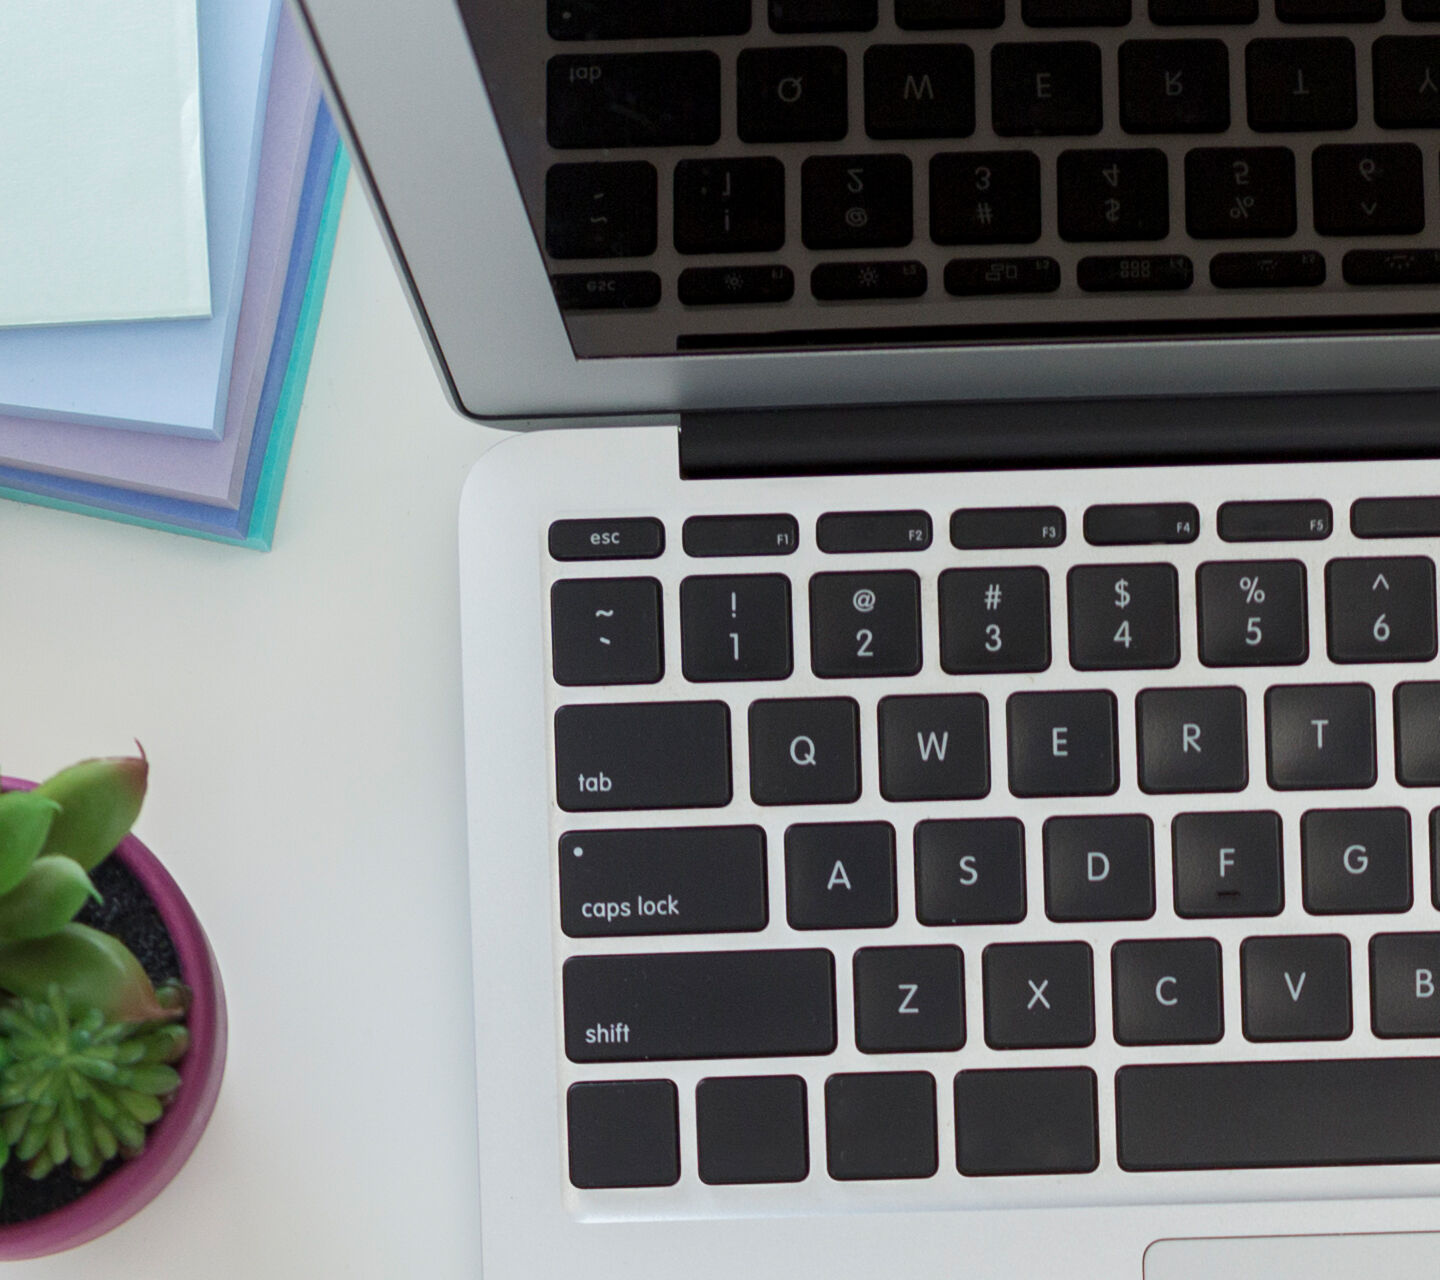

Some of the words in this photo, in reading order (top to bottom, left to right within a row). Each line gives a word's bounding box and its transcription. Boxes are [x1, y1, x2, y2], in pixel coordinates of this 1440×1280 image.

[590, 532, 620, 545] esc
[777, 533, 789, 545] F1
[908, 529, 923, 541] F2
[1042, 526, 1056, 538] F3
[1176, 521, 1191, 533] F4
[1310, 519, 1324, 531] F5
[1114, 578, 1131, 609] $
[1239, 576, 1266, 603] %
[1372, 573, 1390, 590] ^
[731, 591, 737, 618] !
[852, 589, 876, 612] @
[984, 583, 1002, 610] #
[985, 623, 1002, 652] 3
[1113, 620, 1132, 648] 4
[1245, 617, 1262, 645] 5
[1373, 613, 1390, 642] 6
[729, 632, 739, 661] 1
[856, 628, 874, 657] 2
[917, 731, 949, 761] W
[1052, 727, 1068, 756] E
[1182, 723, 1201, 753] R
[1311, 719, 1329, 749] T
[789, 735, 817, 766] Q
[578, 771, 612, 792] tab
[959, 855, 978, 886] S
[1087, 851, 1110, 881] D
[1219, 848, 1235, 877] F
[1343, 844, 1369, 874] G
[827, 860, 851, 890] A
[581, 901, 632, 922] caps
[637, 894, 680, 916] lock
[1027, 979, 1051, 1010] X
[1155, 976, 1178, 1006] C
[1284, 971, 1306, 1002] V
[1415, 968, 1435, 998] B
[898, 984, 919, 1014] Z
[585, 1022, 630, 1044] shift
